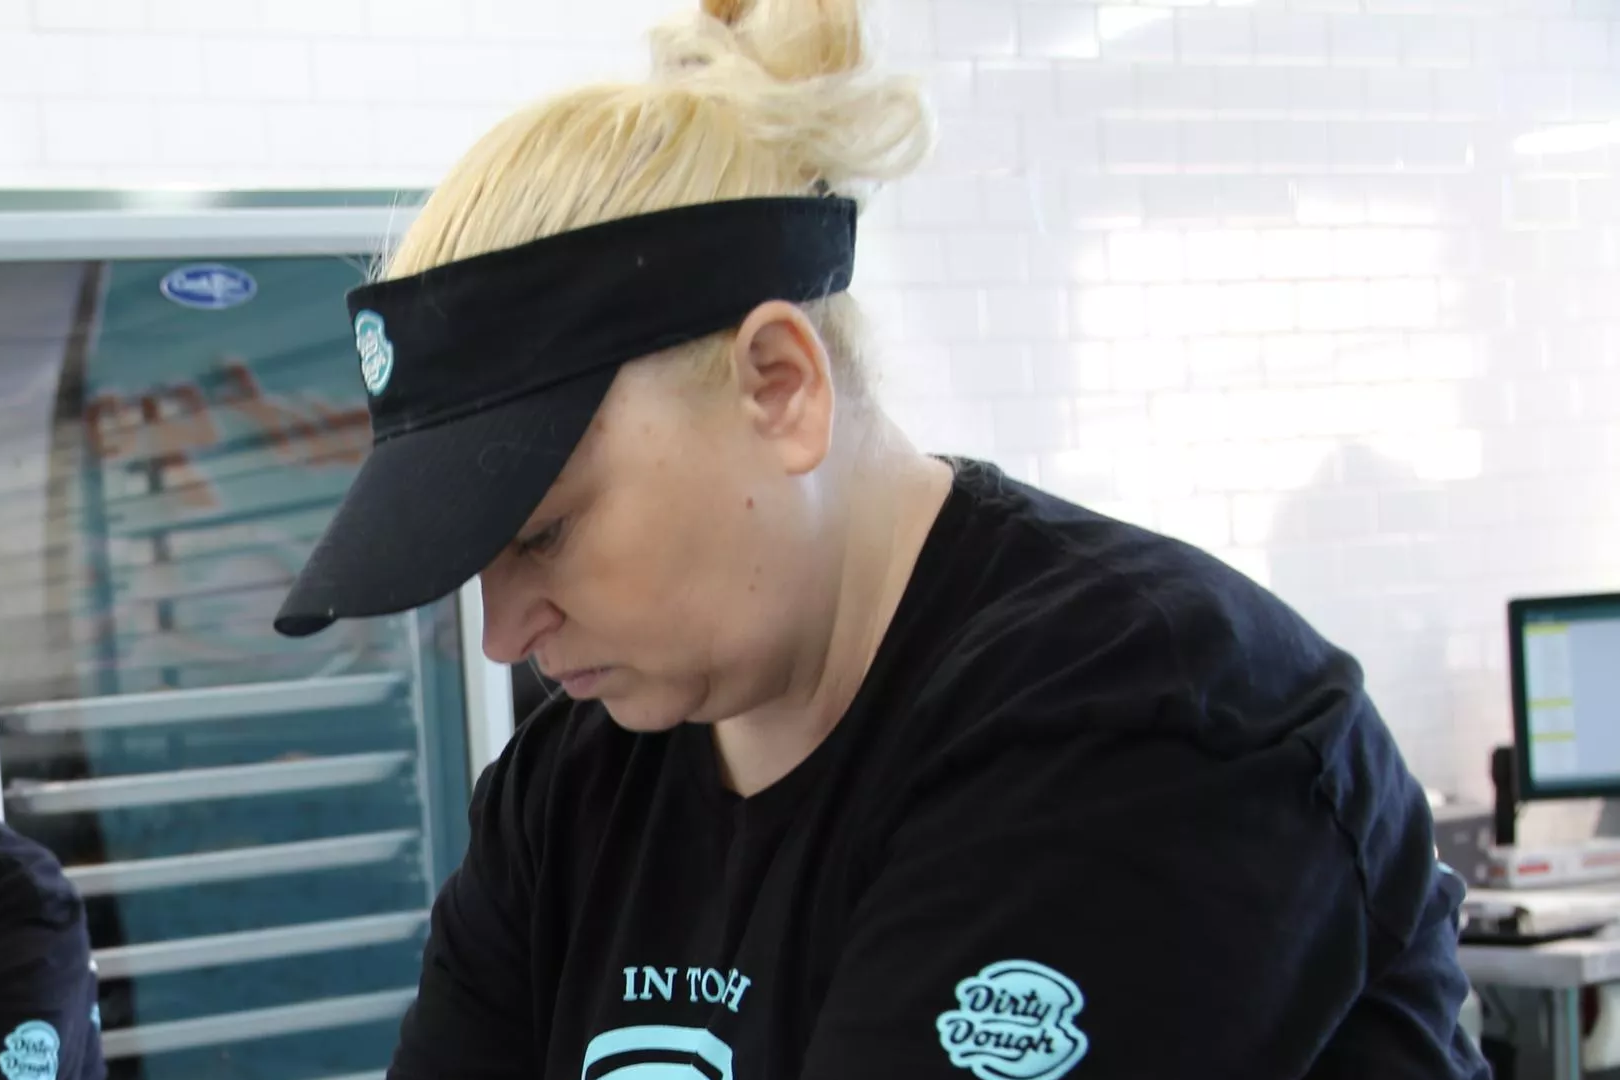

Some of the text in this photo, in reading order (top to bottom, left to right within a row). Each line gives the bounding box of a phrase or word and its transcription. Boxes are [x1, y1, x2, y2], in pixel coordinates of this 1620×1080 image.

[623, 966, 678, 1001] IN
[965, 984, 1052, 1028] Dirty
[946, 1018, 1056, 1062] Dough
